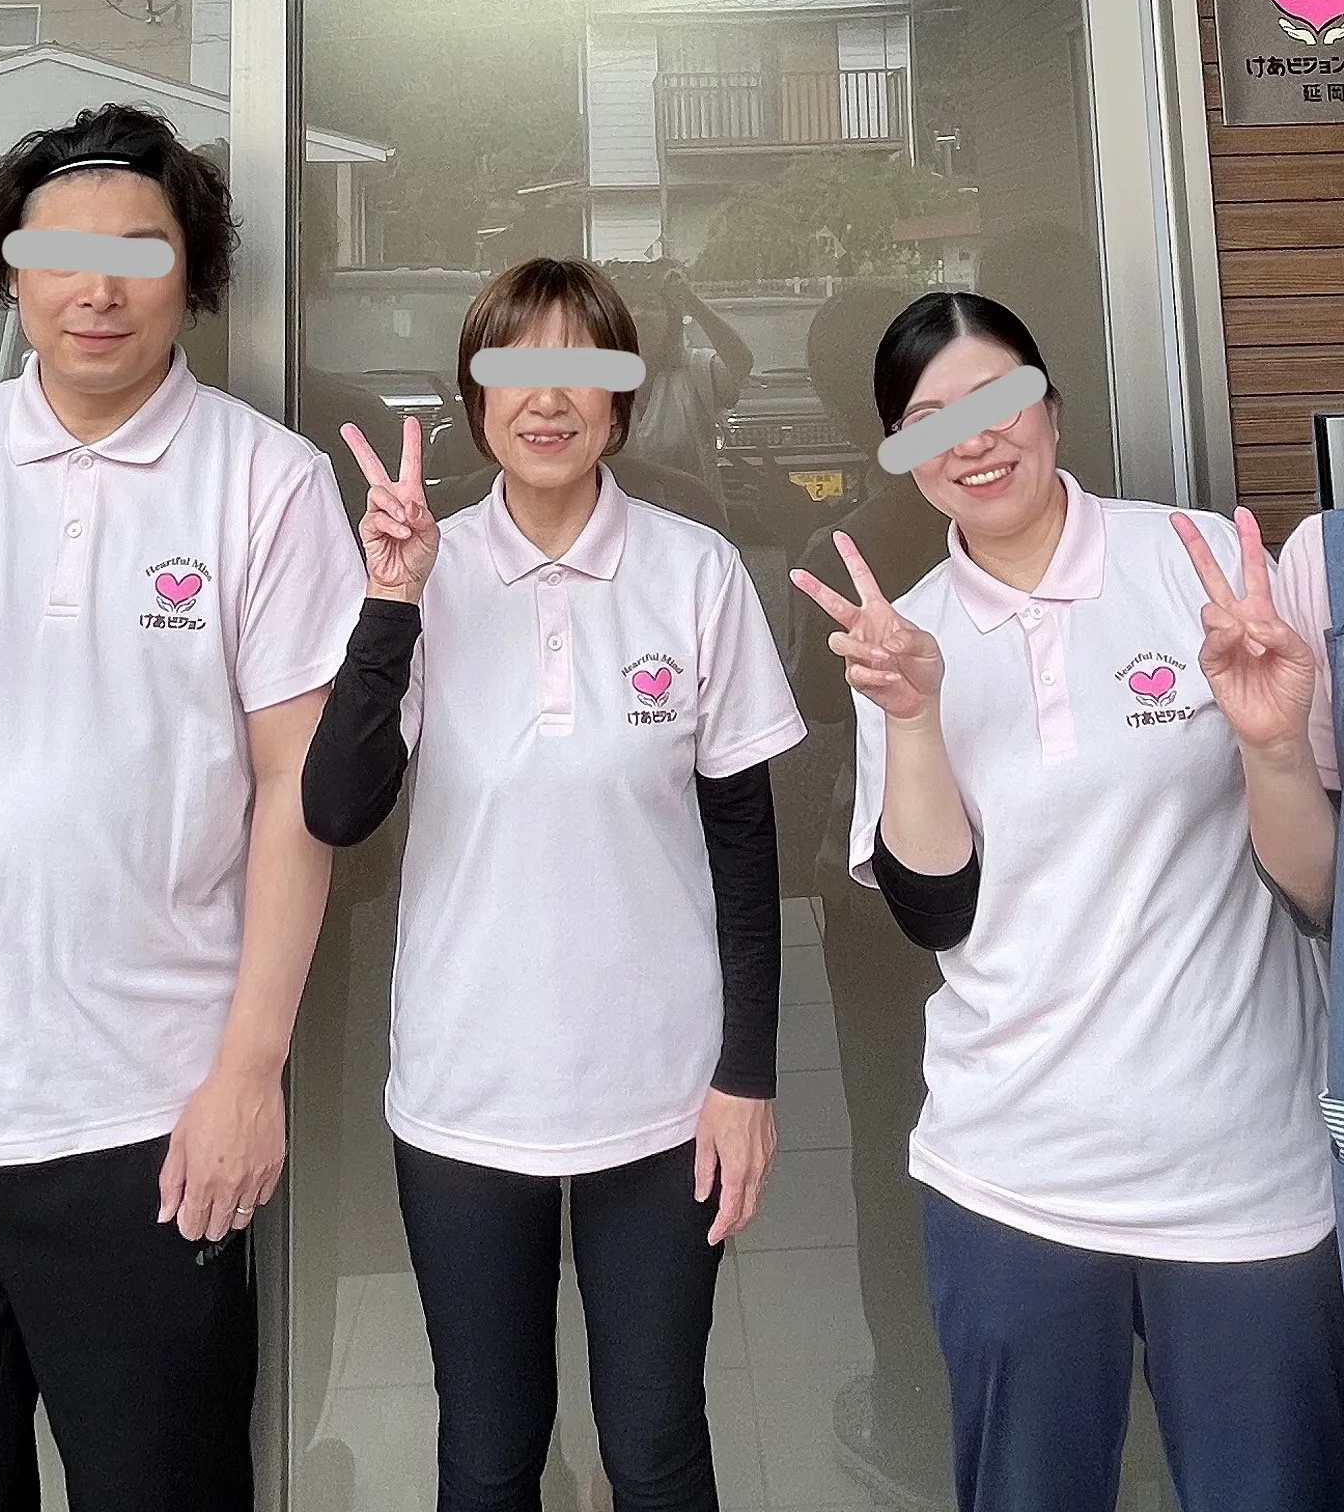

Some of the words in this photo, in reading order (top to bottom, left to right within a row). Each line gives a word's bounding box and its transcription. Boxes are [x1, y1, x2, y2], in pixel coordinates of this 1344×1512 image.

[145, 556, 191, 577] Heartful
[1115, 651, 1153, 681] Heartful
[1155, 651, 1187, 671] Mind
[1125, 706, 1196, 728] けあビジョン
